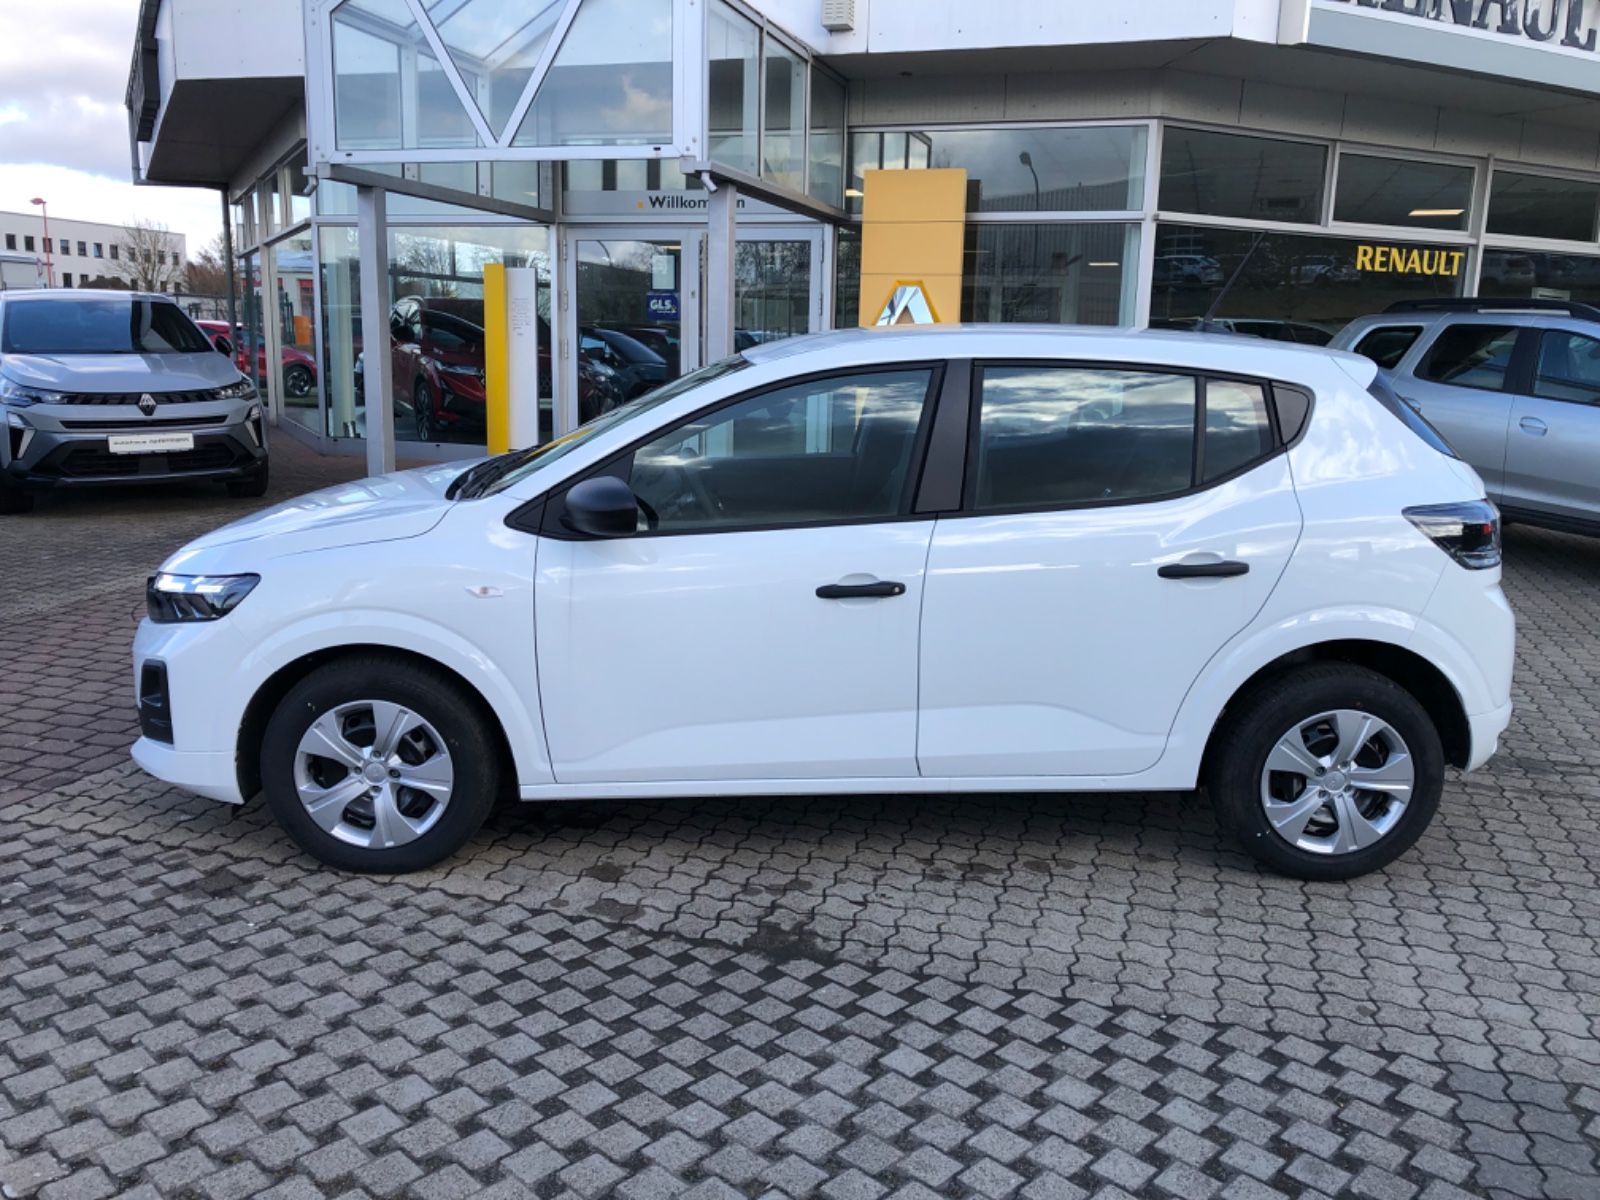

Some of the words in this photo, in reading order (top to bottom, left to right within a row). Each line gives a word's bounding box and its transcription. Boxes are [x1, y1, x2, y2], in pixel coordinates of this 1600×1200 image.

[649, 195, 746, 209] Willkomn
[1356, 245, 1465, 276] RENAULT
[650, 298, 672, 310] GLS
